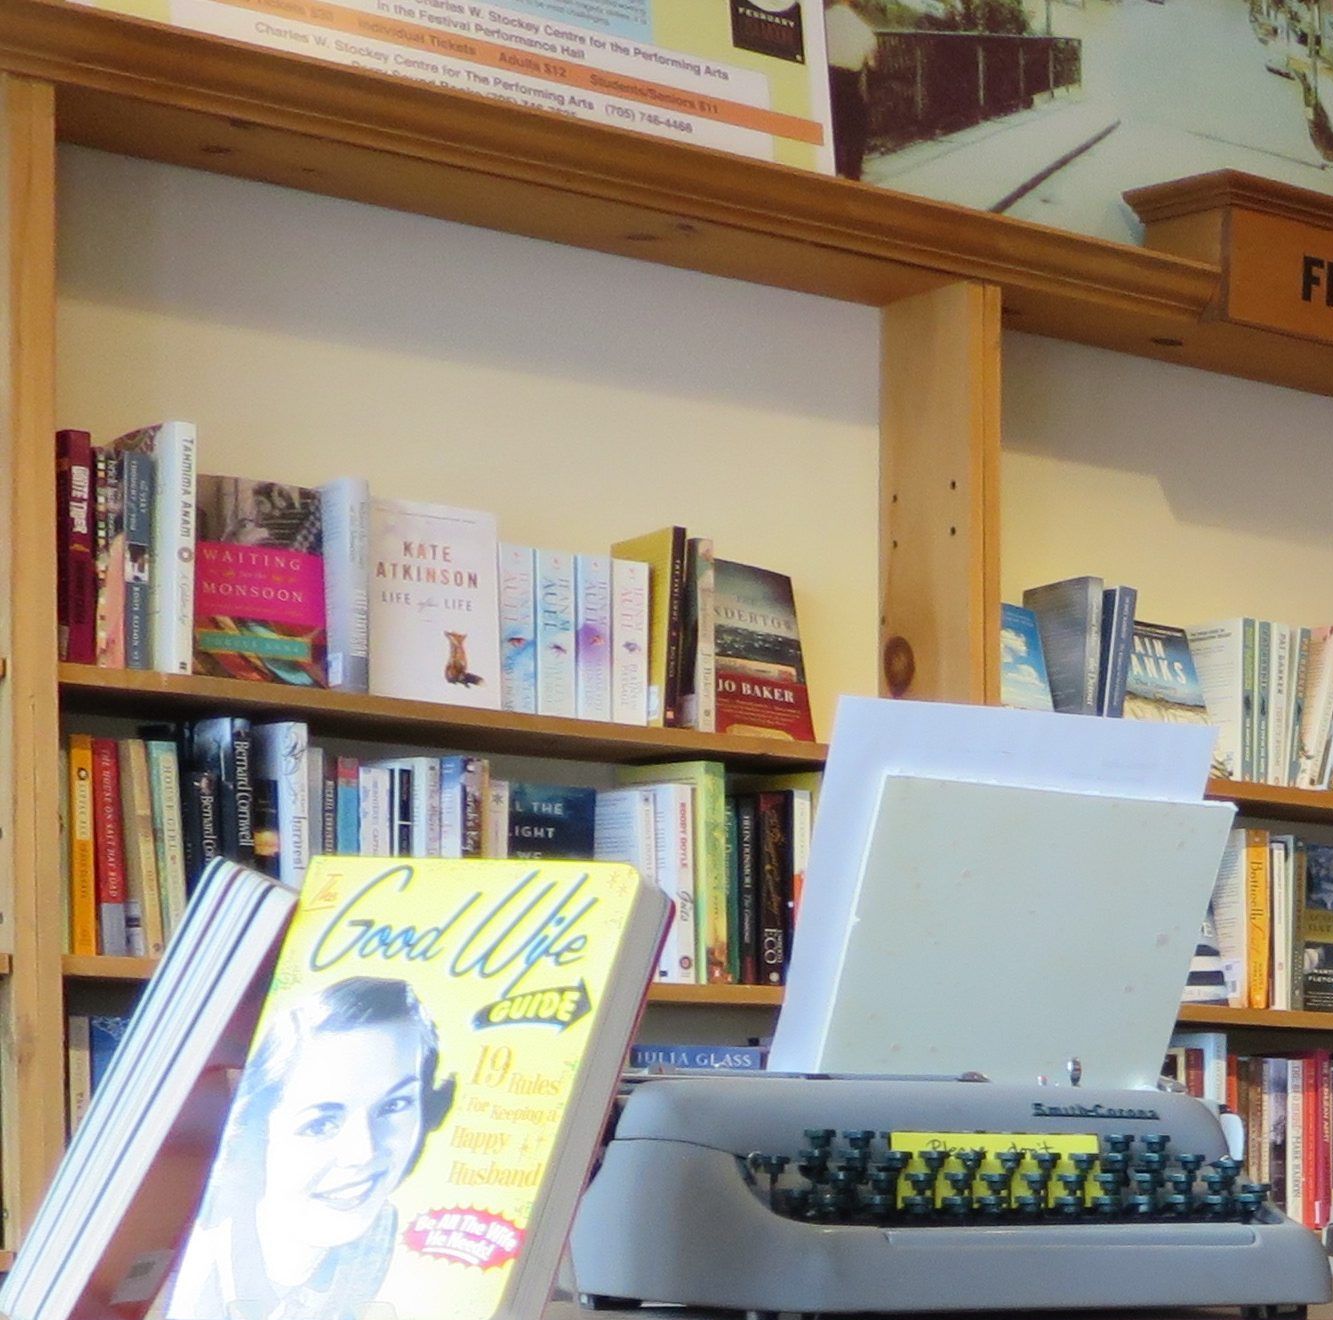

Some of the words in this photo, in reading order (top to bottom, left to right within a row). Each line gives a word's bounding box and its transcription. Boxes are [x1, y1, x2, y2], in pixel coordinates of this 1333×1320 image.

[474, 22, 558, 54] Performance
[562, 46, 584, 59] Hall
[488, 11, 541, 34] Stockey
[544, 23, 585, 44] Centre
[590, 34, 607, 49] for
[610, 39, 630, 55] the
[633, 48, 701, 73] Performing
[704, 64, 729, 81] Arts
[493, 76, 565, 108] Performing
[569, 95, 594, 110] Arts
[181, 438, 194, 496] TAHMIMA
[181, 500, 192, 537] ANAM
[203, 549, 301, 570] WAITING
[404, 541, 452, 562] KATE
[375, 561, 478, 589] ATKINSON
[204, 582, 303, 602] MONSOON
[381, 589, 411, 606] LIFE
[444, 594, 473, 611] LIFE
[717, 679, 735, 694] JO
[741, 681, 794, 704] BAKER
[309, 864, 455, 972] Good
[450, 867, 599, 1002] Wife
[488, 990, 576, 1024] GUIDE
[469, 1043, 514, 1089] 19
[509, 1075, 561, 1097] Rules
[450, 1126, 509, 1152] Happy
[447, 1162, 539, 1187] Husband
